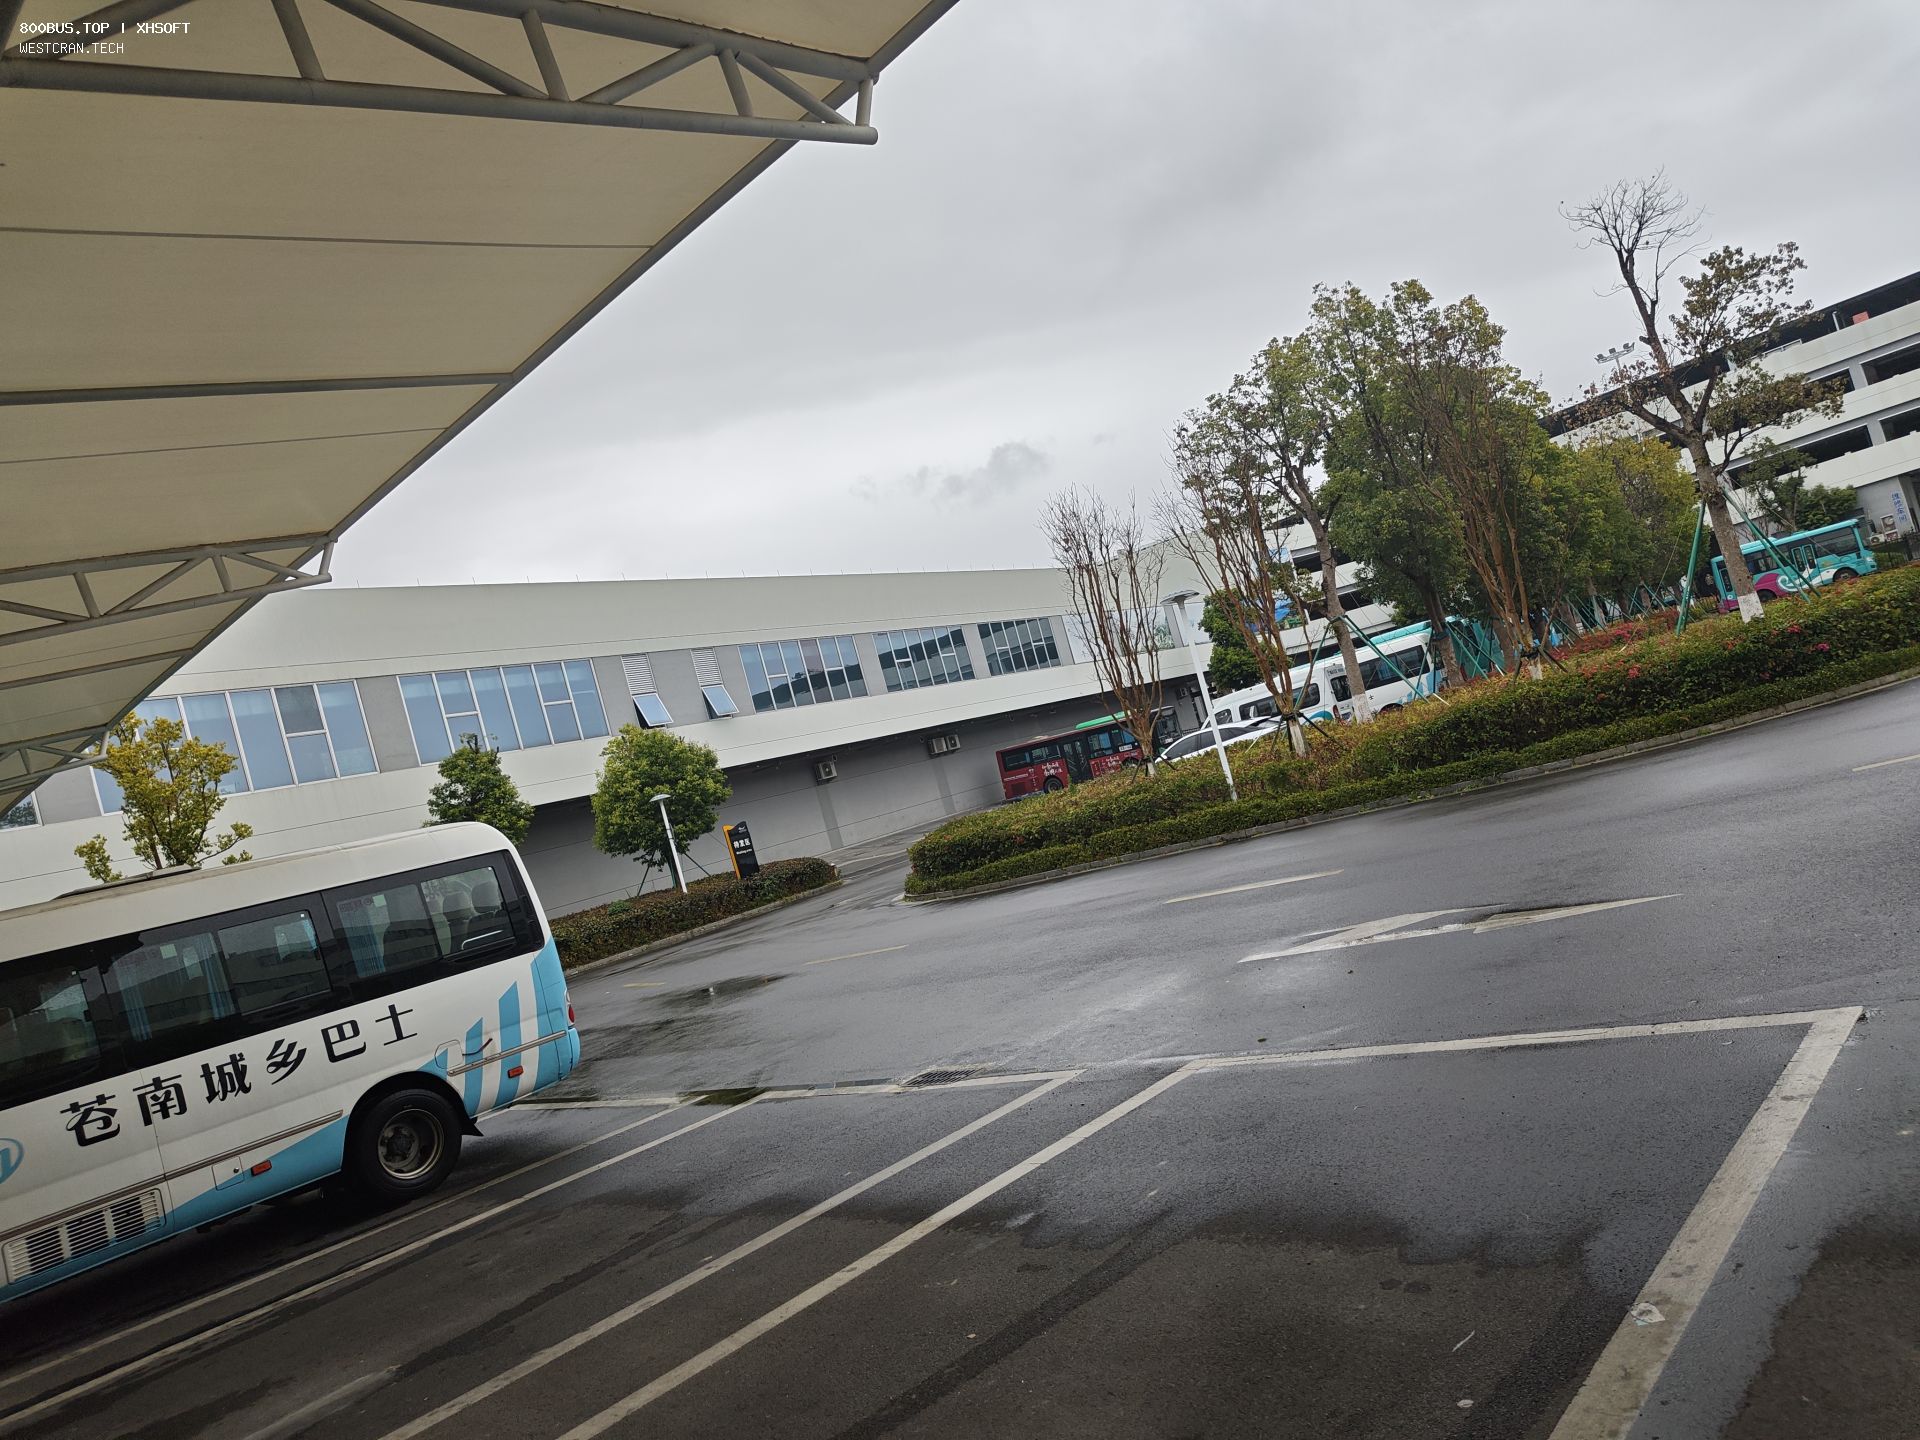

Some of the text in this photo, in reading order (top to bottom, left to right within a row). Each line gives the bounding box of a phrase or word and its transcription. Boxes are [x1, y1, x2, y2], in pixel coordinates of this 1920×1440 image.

[60, 1003, 418, 1147] 苍南城乡巴士
